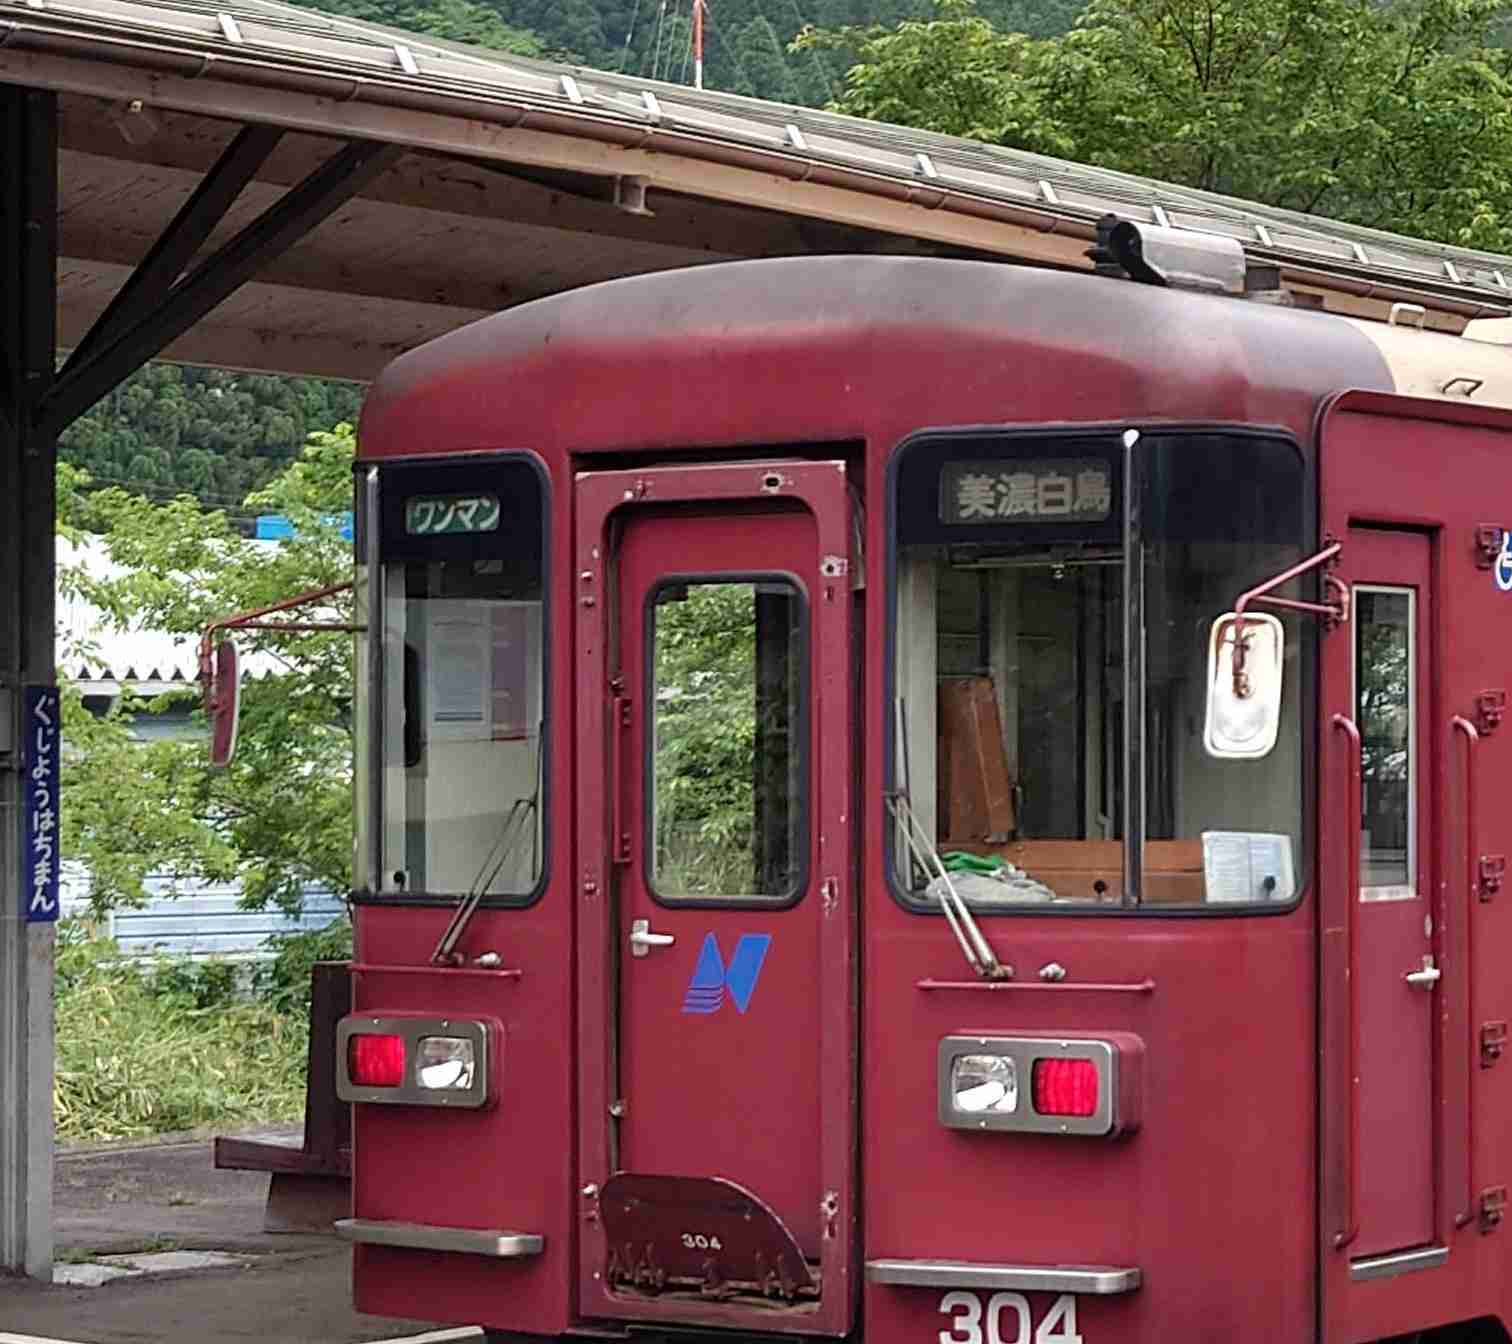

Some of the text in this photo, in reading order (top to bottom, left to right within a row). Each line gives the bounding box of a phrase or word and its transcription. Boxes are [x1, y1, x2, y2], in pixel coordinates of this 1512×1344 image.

[957, 470, 1111, 519] 美濃白鳥
[415, 498, 500, 534] ワンマン
[681, 1233, 723, 1251] 304
